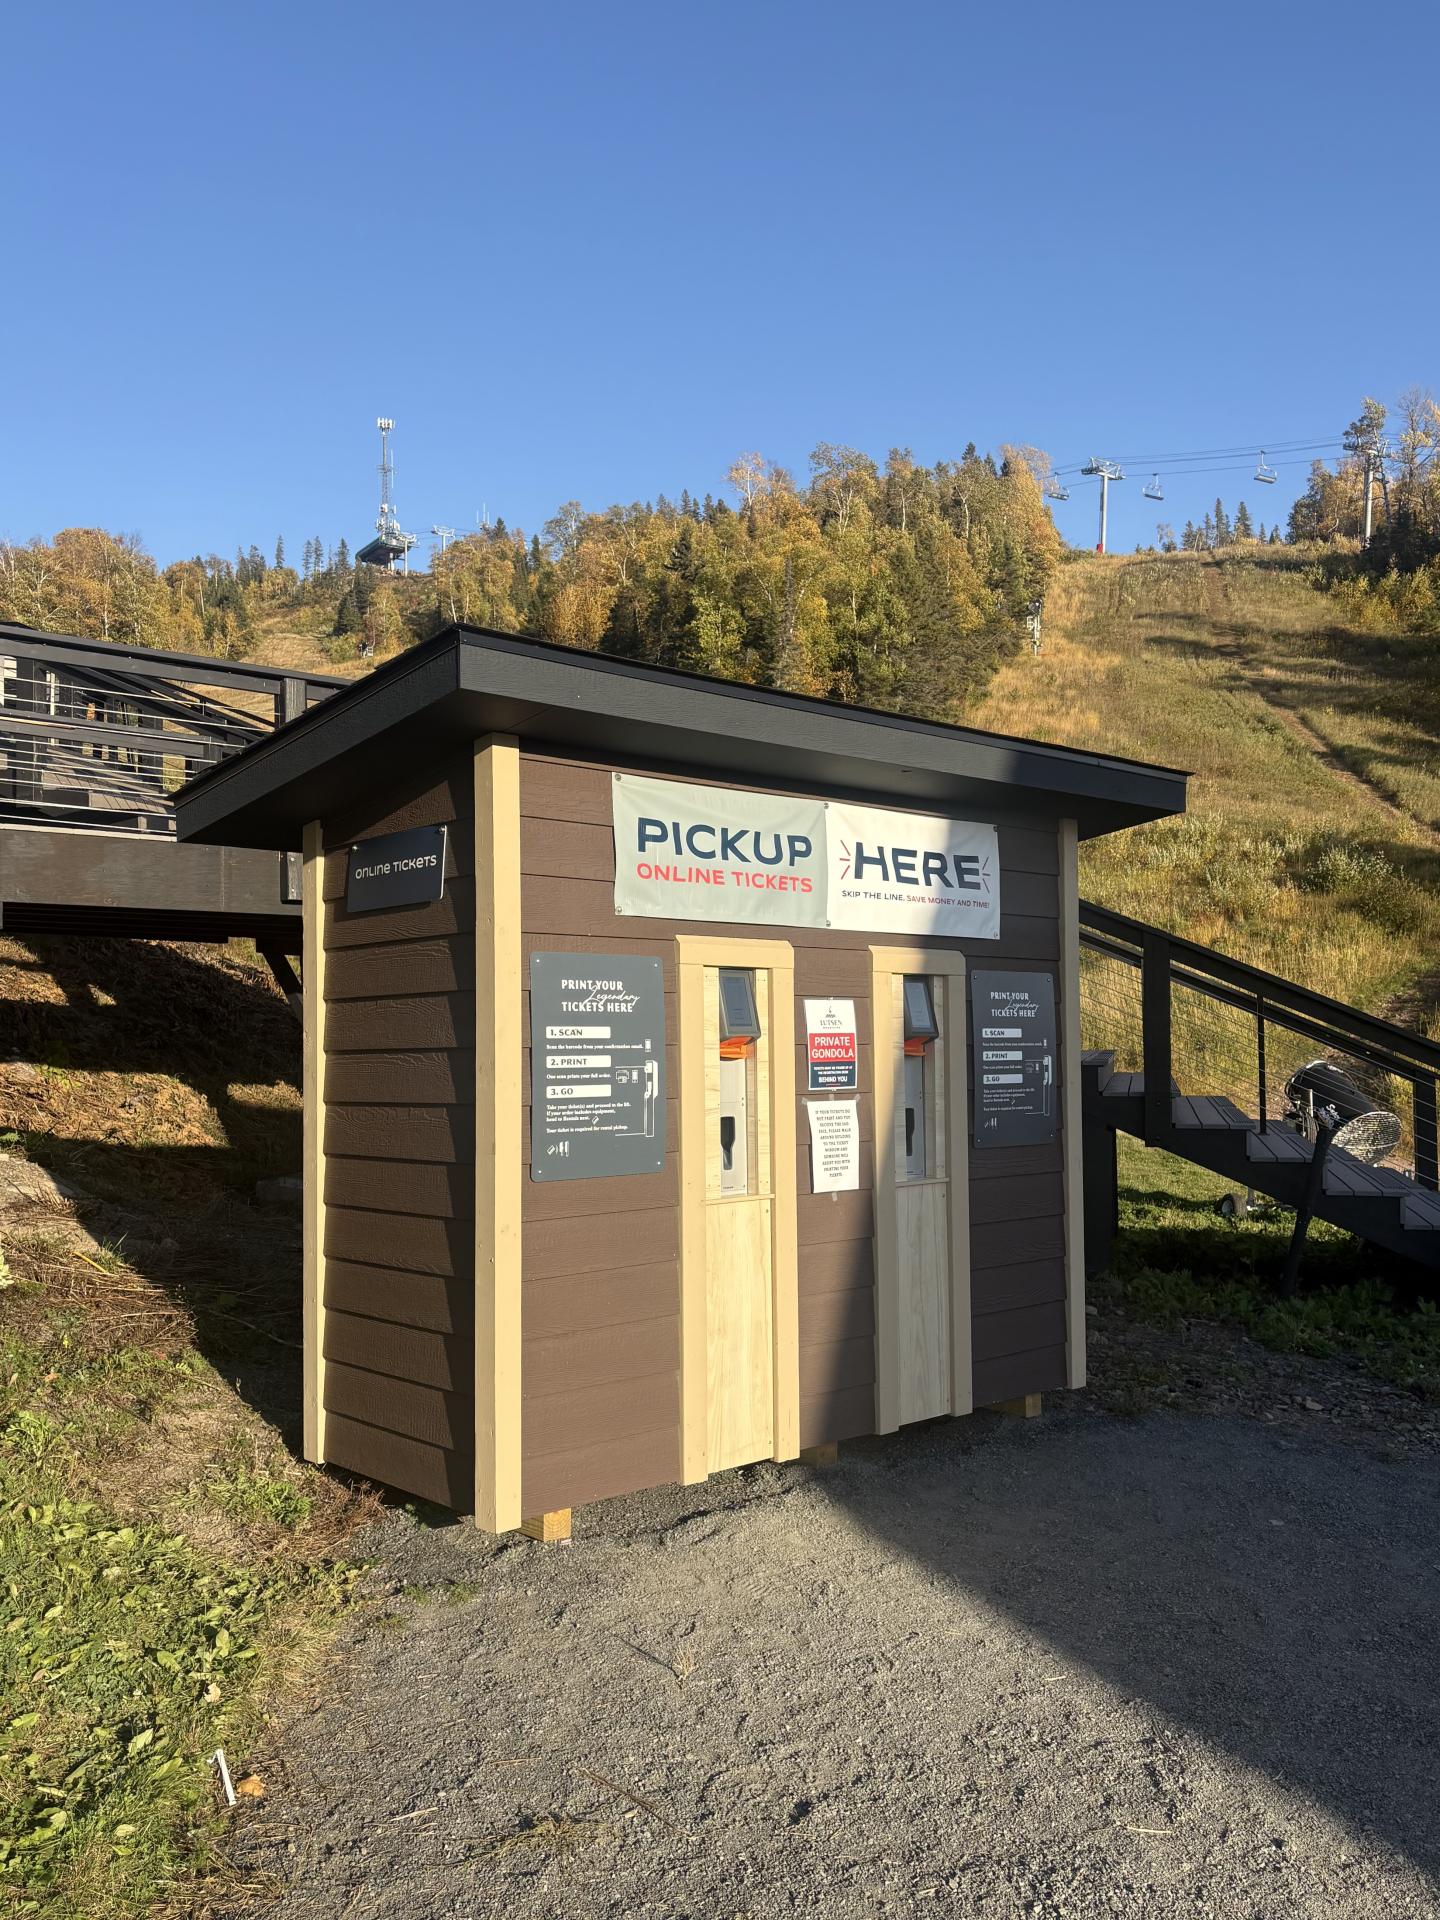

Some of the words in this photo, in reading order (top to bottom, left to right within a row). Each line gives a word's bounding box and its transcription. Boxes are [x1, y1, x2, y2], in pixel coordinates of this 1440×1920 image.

[637, 817, 813, 867] PICKUP
[853, 841, 983, 890] HERE
[636, 862, 726, 886] ONLINE
[731, 871, 814, 893] TICKETS
[841, 890, 861, 898] SKIP
[863, 891, 882, 900] THE
[906, 895, 927, 904] SAVE
[928, 897, 956, 905] MONEY
[561, 980, 592, 990] PRINT
[595, 981, 624, 991] YOUR
[582, 985, 640, 1007] Legendary
[990, 991, 1010, 1000] PRINT
[1012, 992, 1030, 1000] YOUR
[561, 1002, 604, 1012] TICKETS
[607, 1002, 633, 1013] HERE
[992, 1009, 1018, 1017] TICKETS
[1019, 1010, 1036, 1018] HERE
[550, 1029, 558, 1037] 1.
[558, 1028, 583, 1037] SCAN
[814, 1036, 850, 1046] PRIVATE
[812, 1048, 854, 1058] GONDOLA
[561, 1058, 588, 1066] PRINT
[551, 1088, 559, 1096] 3.
[560, 1088, 574, 1096] GO
